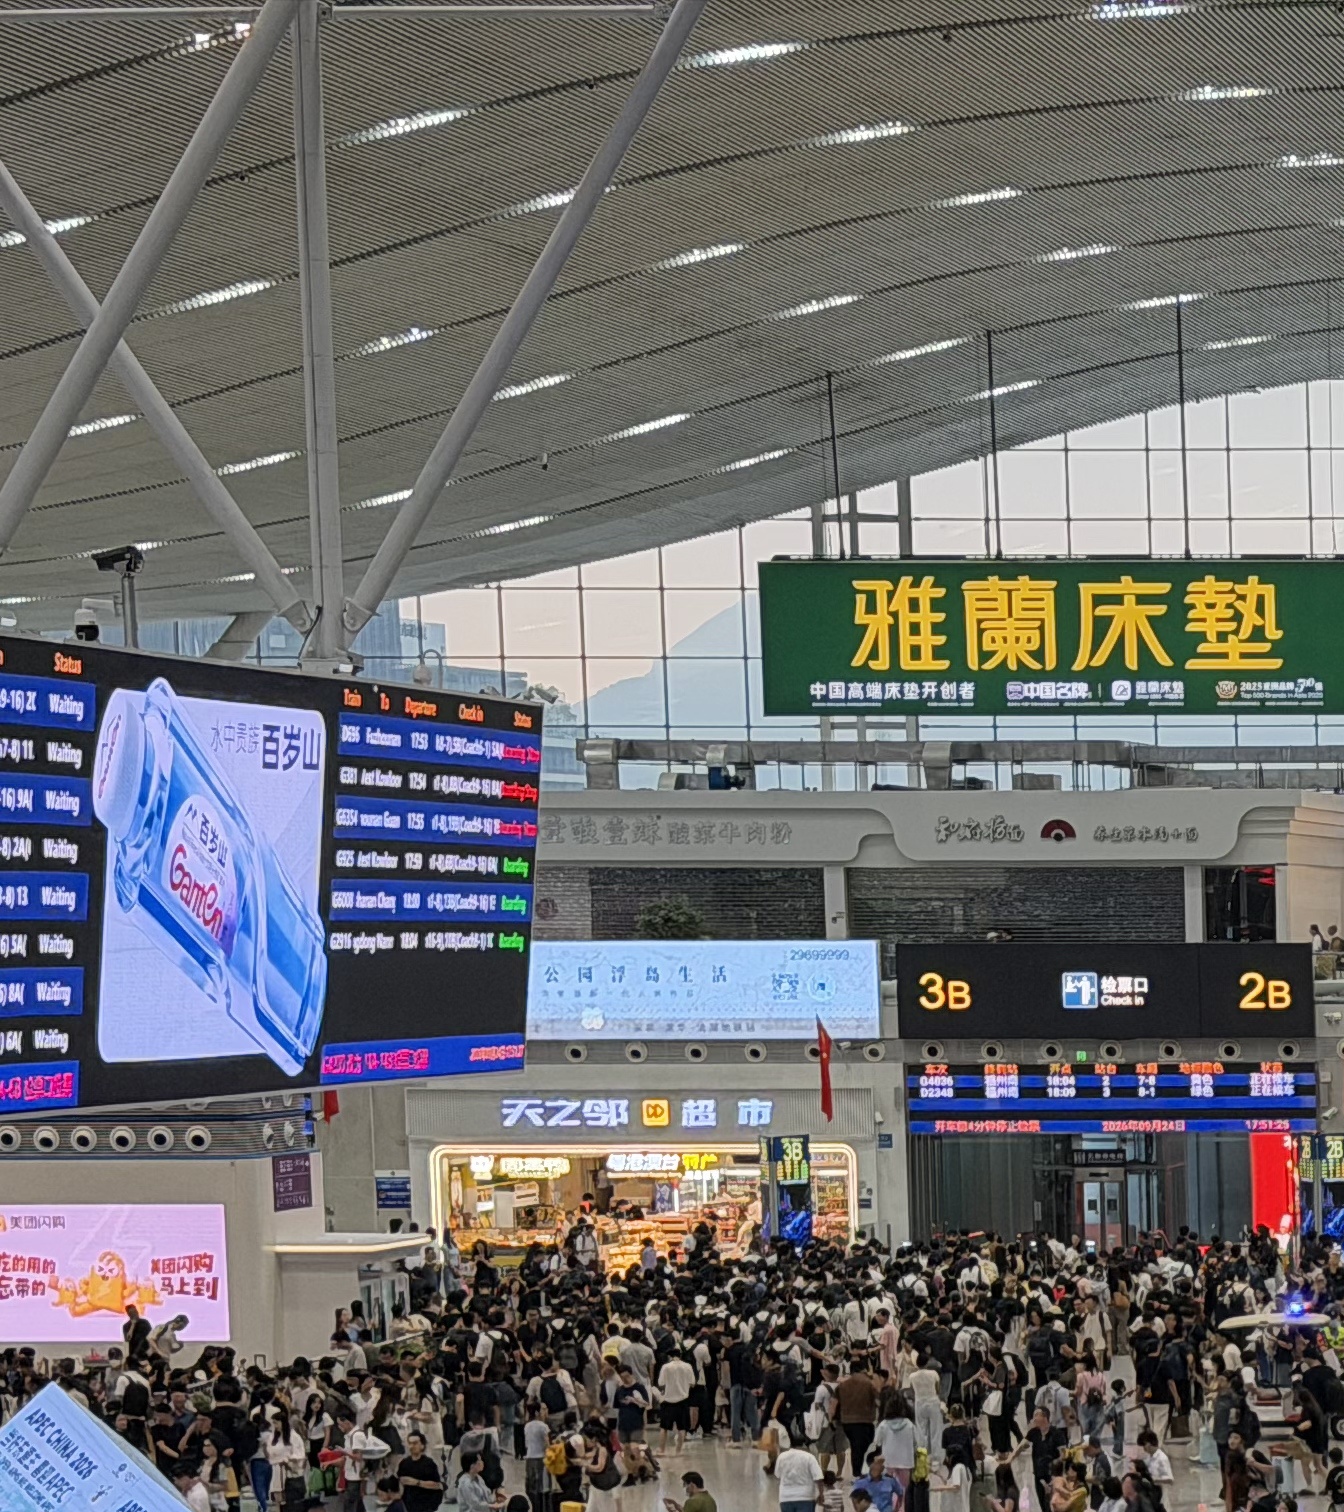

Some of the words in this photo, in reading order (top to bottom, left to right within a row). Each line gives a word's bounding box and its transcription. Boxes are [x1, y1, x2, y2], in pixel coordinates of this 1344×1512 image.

[850, 575, 1284, 671] 雅蘭床墊
[54, 652, 82, 675] Status
[810, 681, 976, 699] 中国高端床垫开创者
[49, 693, 84, 721] Waiting
[47, 742, 82, 769] Waiting
[262, 723, 322, 771] 百岁山
[45, 790, 80, 817] Waiting
[43, 838, 79, 864] Waiting
[199, 813, 228, 868] 百岁山
[41, 886, 76, 912] Waiting
[169, 843, 224, 938] Ganten
[38, 934, 73, 959] Waiting
[37, 982, 71, 1006] Waiting
[918, 972, 973, 1011] 3B
[1101, 976, 1149, 994] 检票口
[1238, 972, 1293, 1010] 2B
[1101, 994, 1134, 1007] Check
[1134, 994, 1145, 1007] in
[34, 1029, 69, 1053] Waiting
[502, 1099, 629, 1127] 天之邻
[681, 1099, 774, 1127] 超市
[783, 1142, 803, 1161] 3B
[1327, 1141, 1344, 1159] 2B
[10, 1215, 66, 1230] 美团闪购
[151, 1252, 214, 1274] 美团闪购
[160, 1276, 220, 1301] 马上到
[25, 1408, 55, 1437] APEC
[46, 1428, 79, 1462] CHINA
[69, 1452, 98, 1480] 2026
